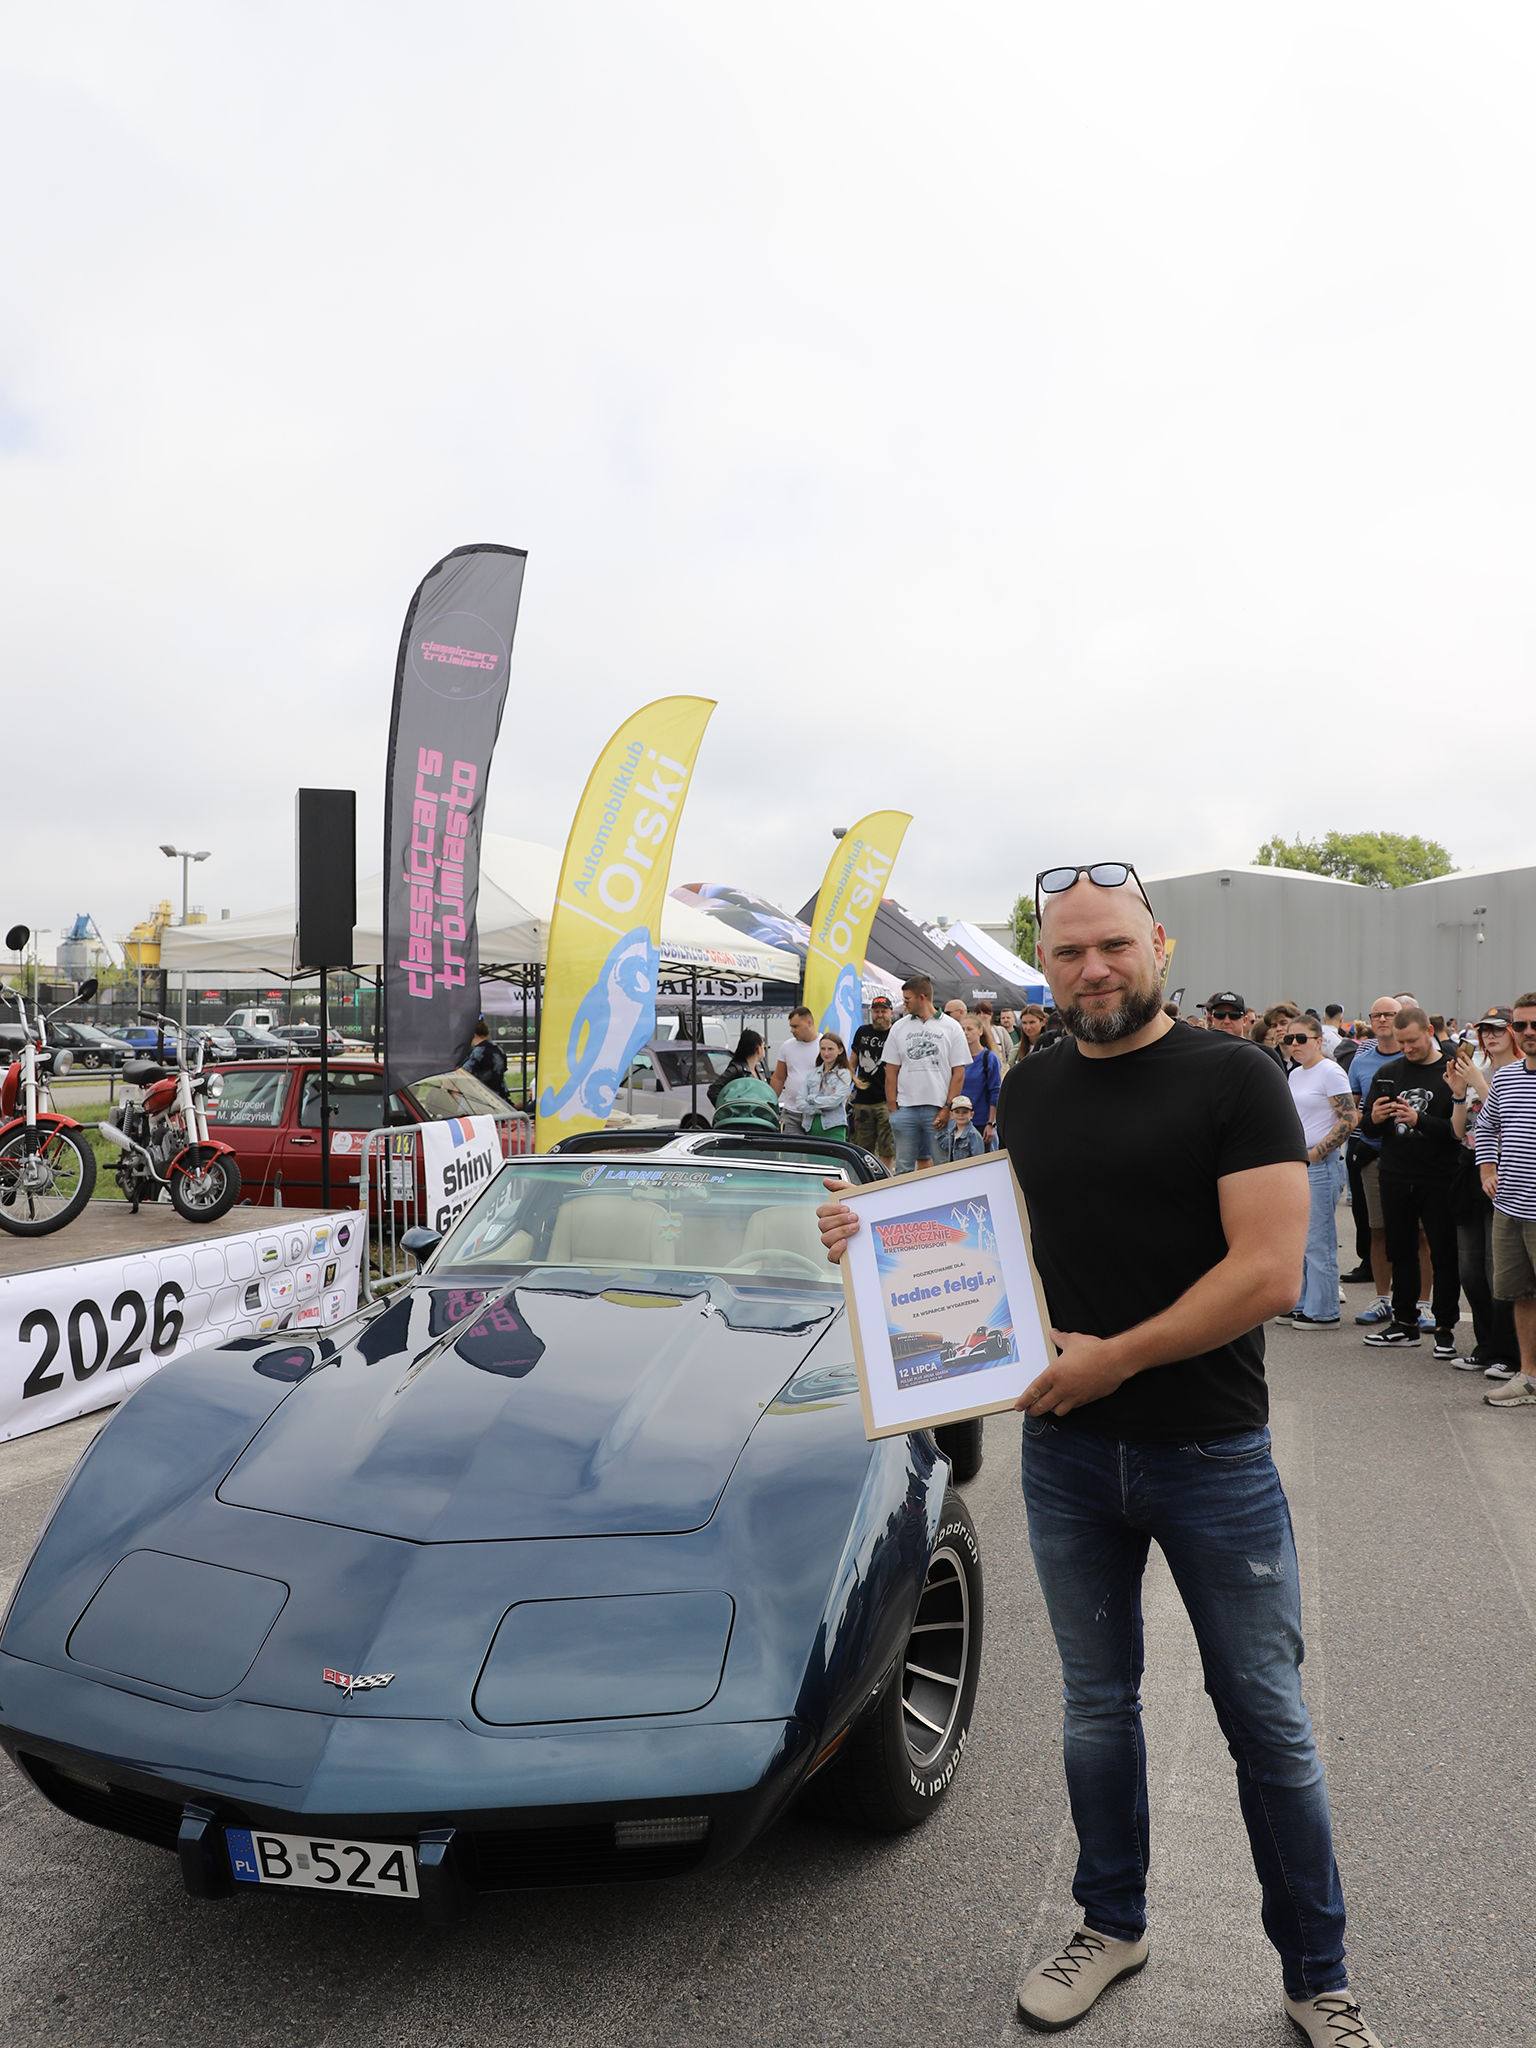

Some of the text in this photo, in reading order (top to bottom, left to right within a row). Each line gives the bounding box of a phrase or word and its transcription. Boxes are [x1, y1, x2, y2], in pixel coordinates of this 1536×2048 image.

[421, 641, 498, 662] classiccars
[573, 741, 644, 897] Automobilklub
[598, 748, 688, 913] Orski
[399, 747, 443, 999] classiccars
[433, 760, 477, 990] trójmiasto
[818, 839, 864, 943] Automobilklub
[830, 844, 893, 954] Orski
[660, 941, 709, 962] OBILKLUB
[220, 1099, 265, 1109] M. Strocen
[217, 1111, 228, 1120] M.
[443, 1148, 493, 1197] Shiny
[875, 1220, 938, 1237] WAKACJE
[881, 1229, 951, 1247] KLASYCZNIE
[883, 1241, 947, 1254] #RETROMOTORSPORT
[891, 1286, 942, 1307] ładne
[920, 1306, 946, 1316] WSPARCIE
[946, 1298, 980, 1310] WYDARZENIA
[19, 1281, 185, 1399] 2026
[899, 1362, 938, 1378] 12 LIPCA
[930, 1728, 967, 1797] Radial
[235, 1861, 254, 1873] PL
[256, 1836, 409, 1893] B 524
